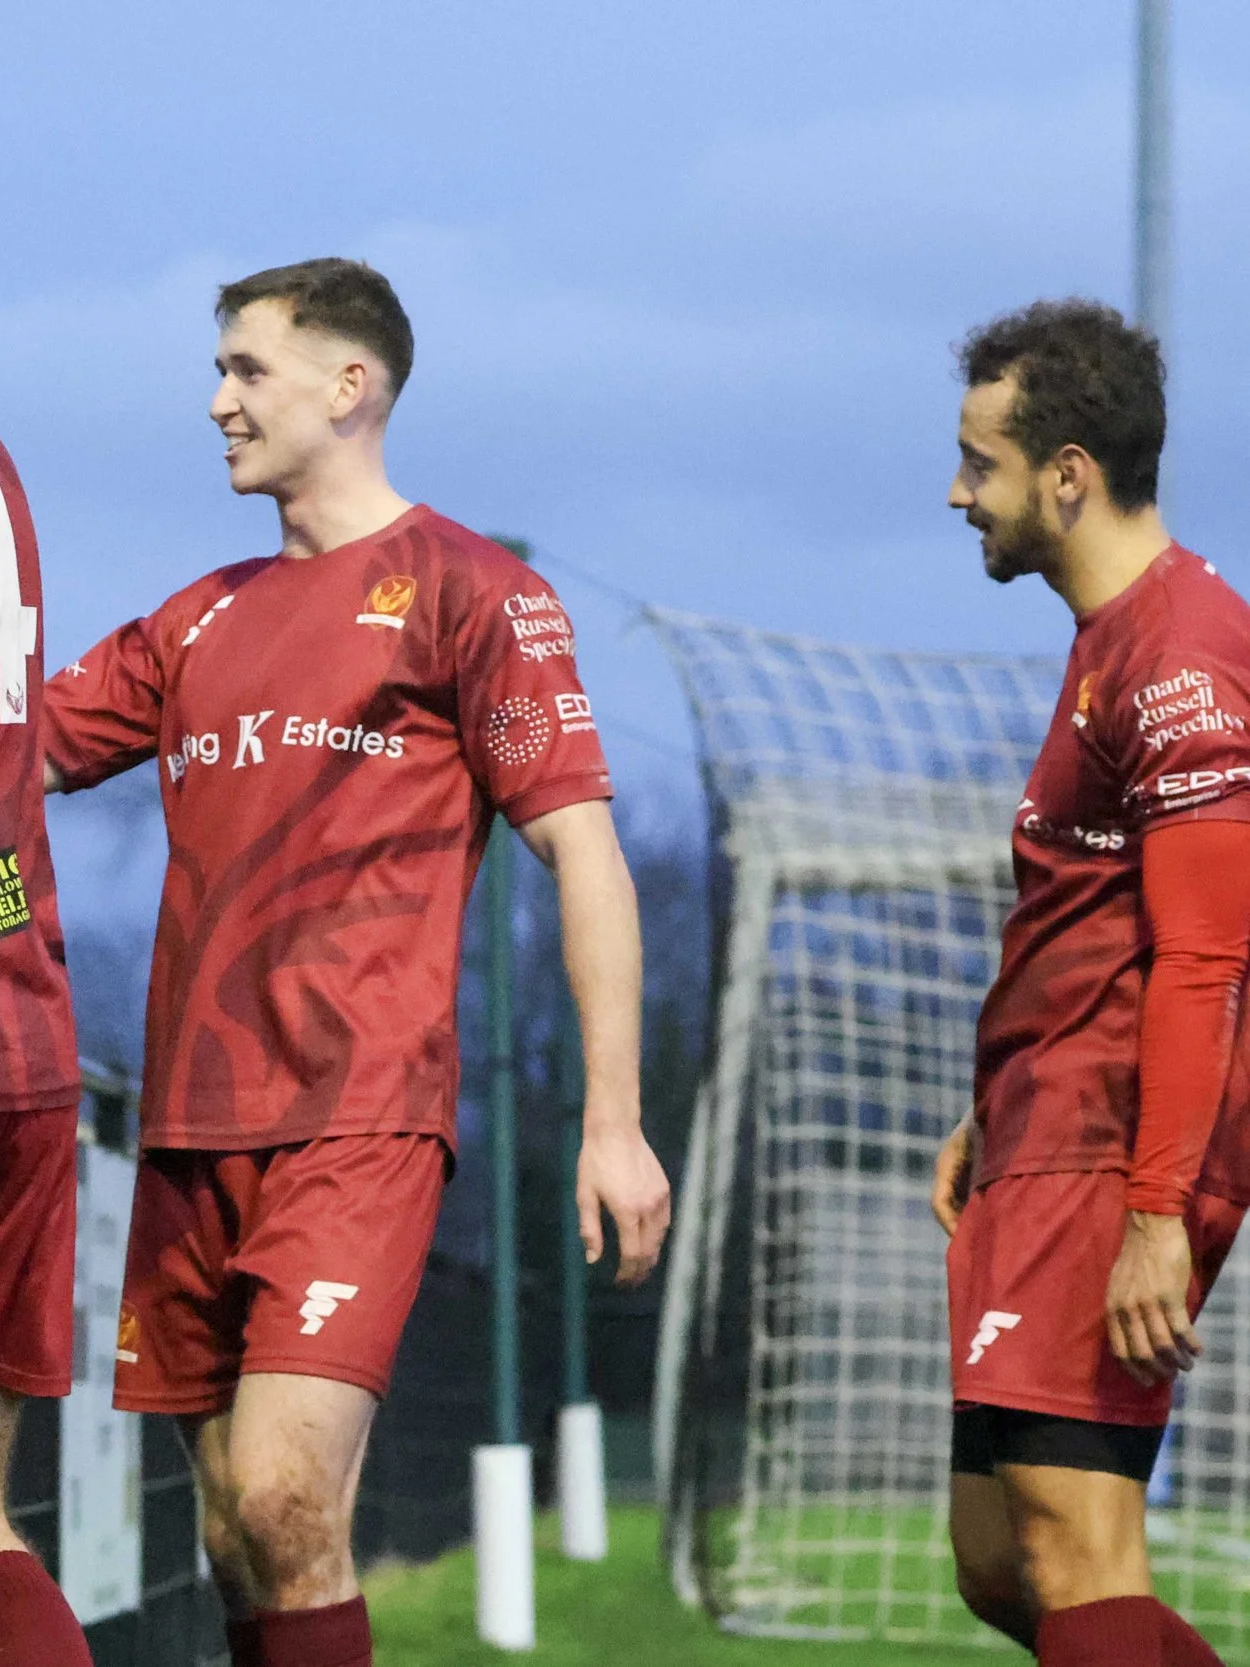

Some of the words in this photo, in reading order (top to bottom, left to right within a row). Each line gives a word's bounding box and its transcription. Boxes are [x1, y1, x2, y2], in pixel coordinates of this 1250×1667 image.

[554, 692, 592, 720] ED
[1133, 668, 1214, 709] Charles
[1138, 686, 1215, 732] Russell
[232, 710, 275, 770] K
[281, 715, 405, 759] Estates
